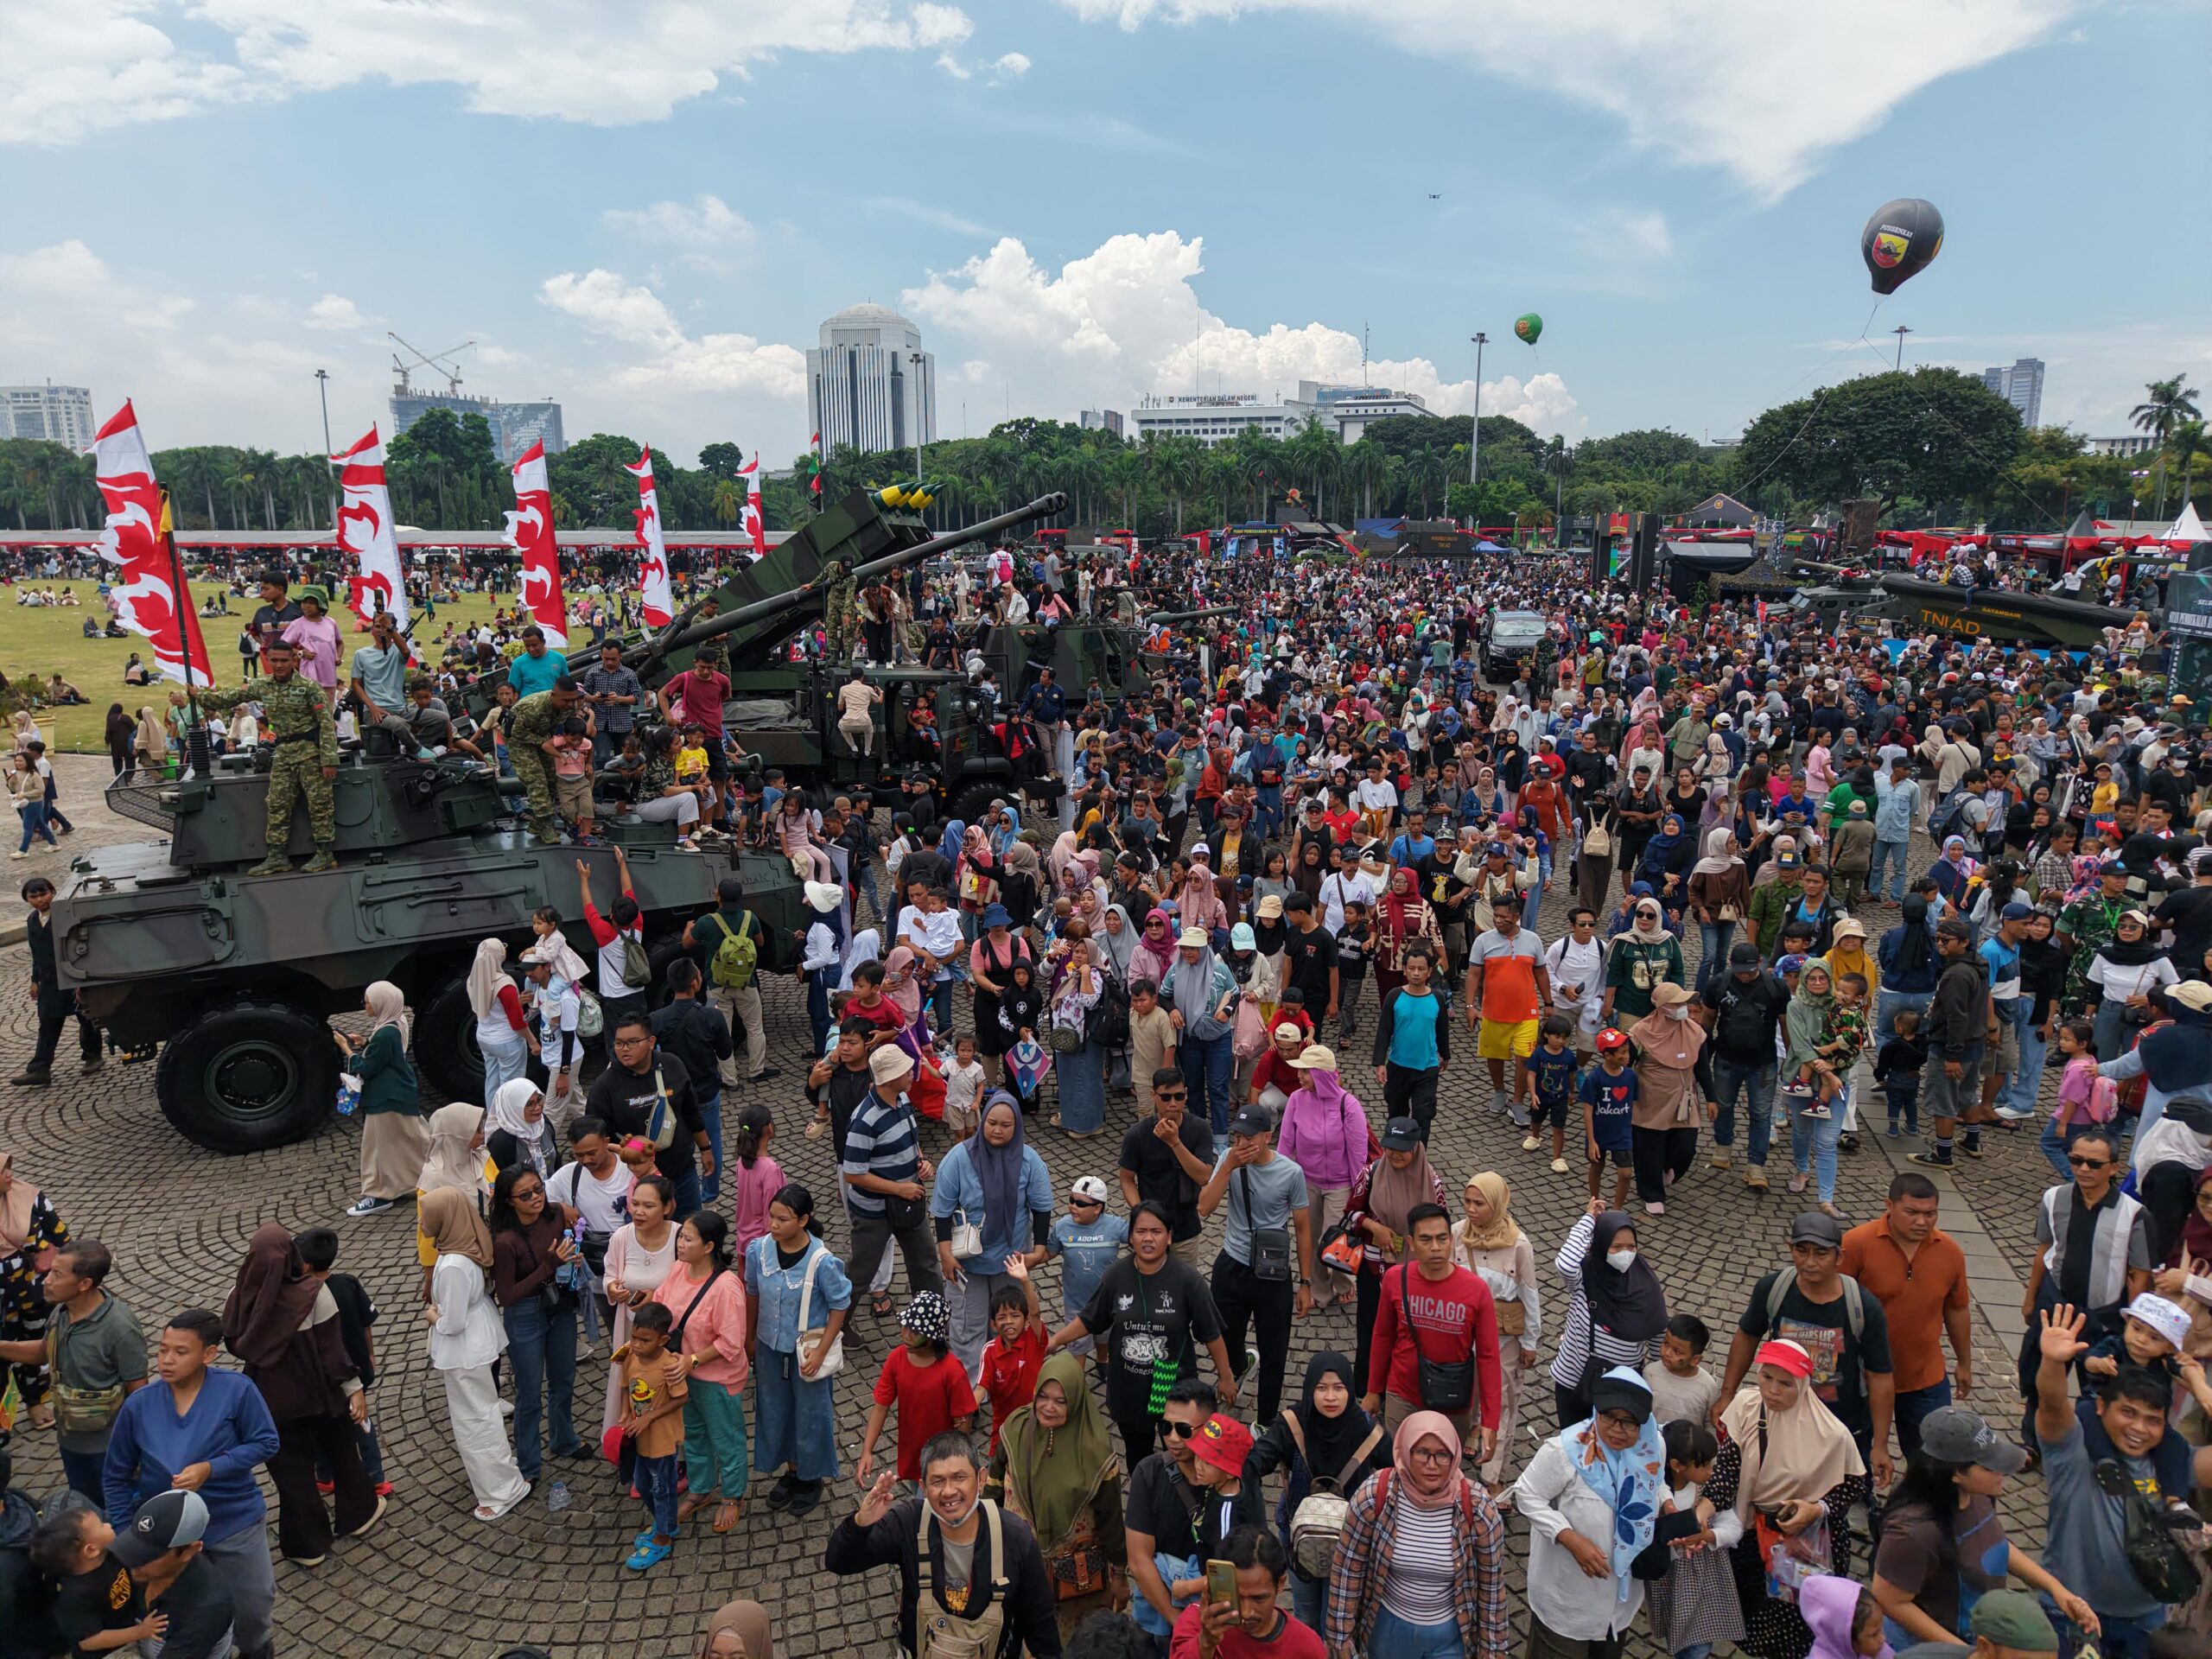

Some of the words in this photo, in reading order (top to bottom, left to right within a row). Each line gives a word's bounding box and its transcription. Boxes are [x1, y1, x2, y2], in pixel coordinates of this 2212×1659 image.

[1921, 609, 1948, 628] TNI
[1949, 618, 1980, 635] AD
[1602, 1086, 1611, 1102] I
[1819, 1330, 1836, 1343] UP
